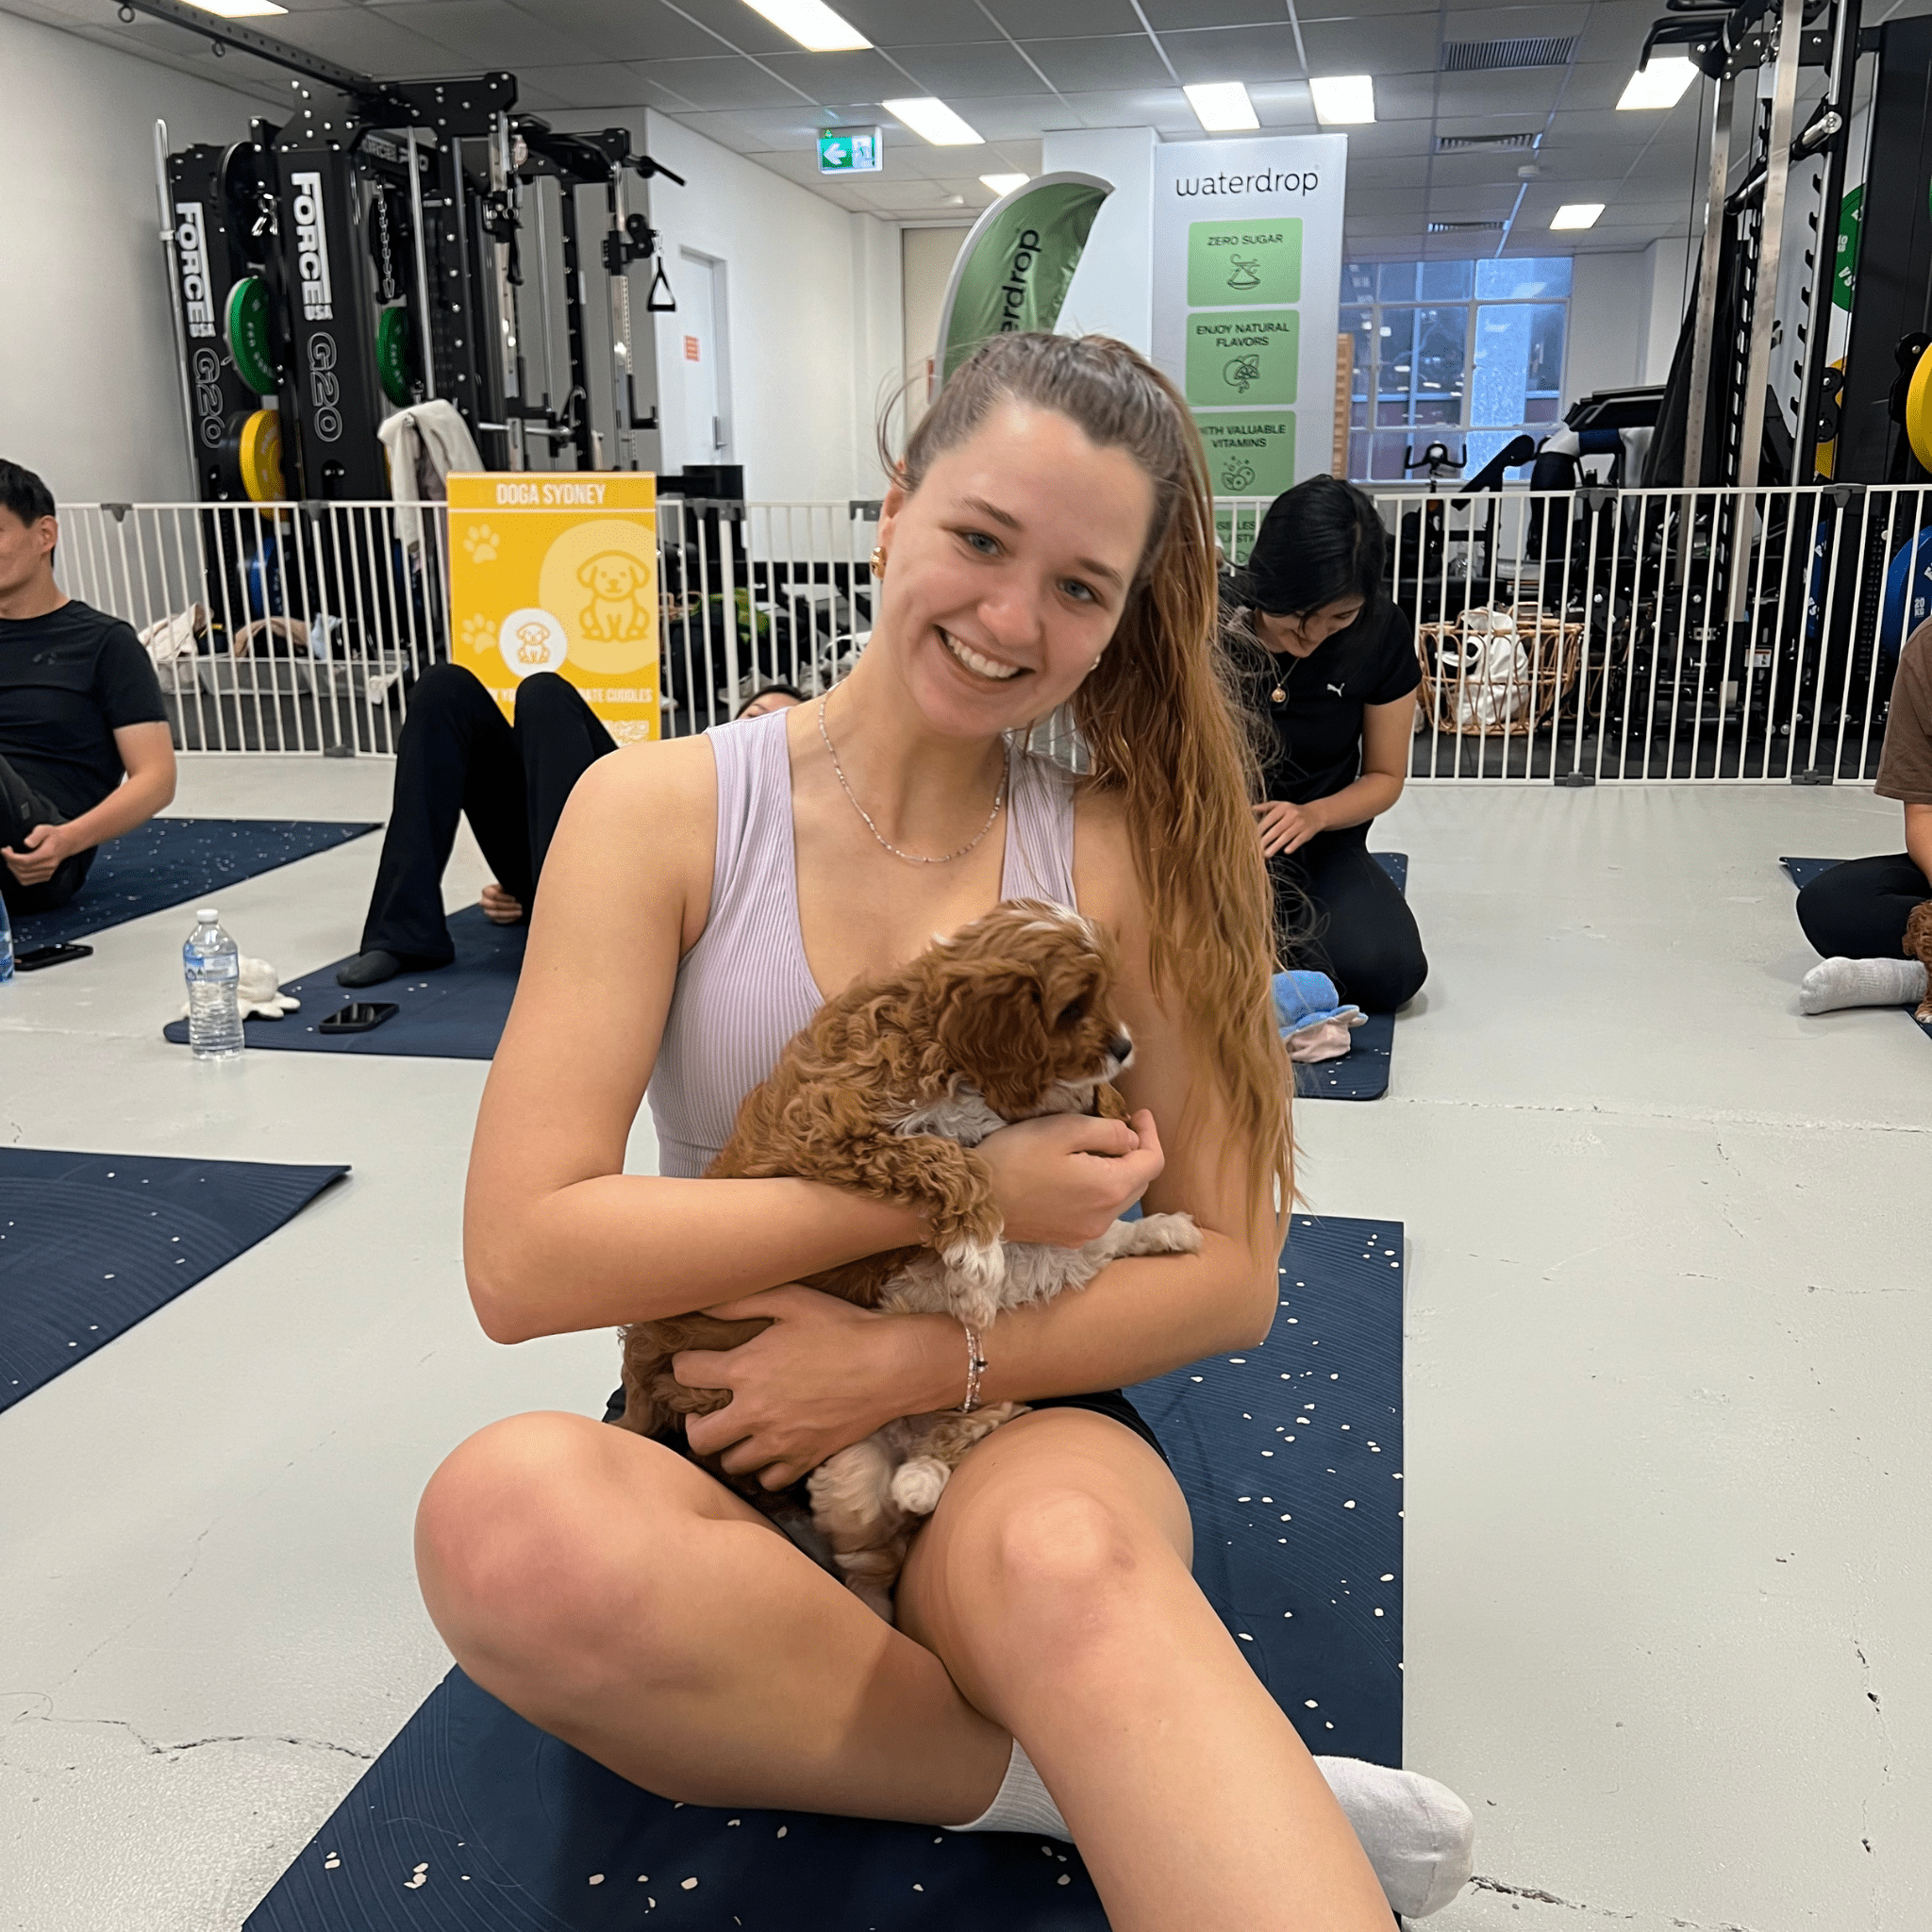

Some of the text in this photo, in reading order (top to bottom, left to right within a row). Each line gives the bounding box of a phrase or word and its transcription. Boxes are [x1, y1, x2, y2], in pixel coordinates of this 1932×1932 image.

[1176, 168, 1319, 196] waterdrop
[291, 172, 332, 304] FORCE
[1208, 234, 1283, 246] ZERO SUGAR
[175, 202, 215, 323] FORCE
[1000, 229, 1042, 332] erdrop
[1196, 323, 1290, 335] ENJOY NATURAL
[1216, 337, 1270, 347] FLAVORS
[192, 347, 225, 449] G20
[307, 332, 342, 442] G20
[1226, 424, 1286, 435] VALUABLE
[1212, 438, 1267, 448] VITAMINS
[496, 482, 606, 505] DOGA SYDNEY
